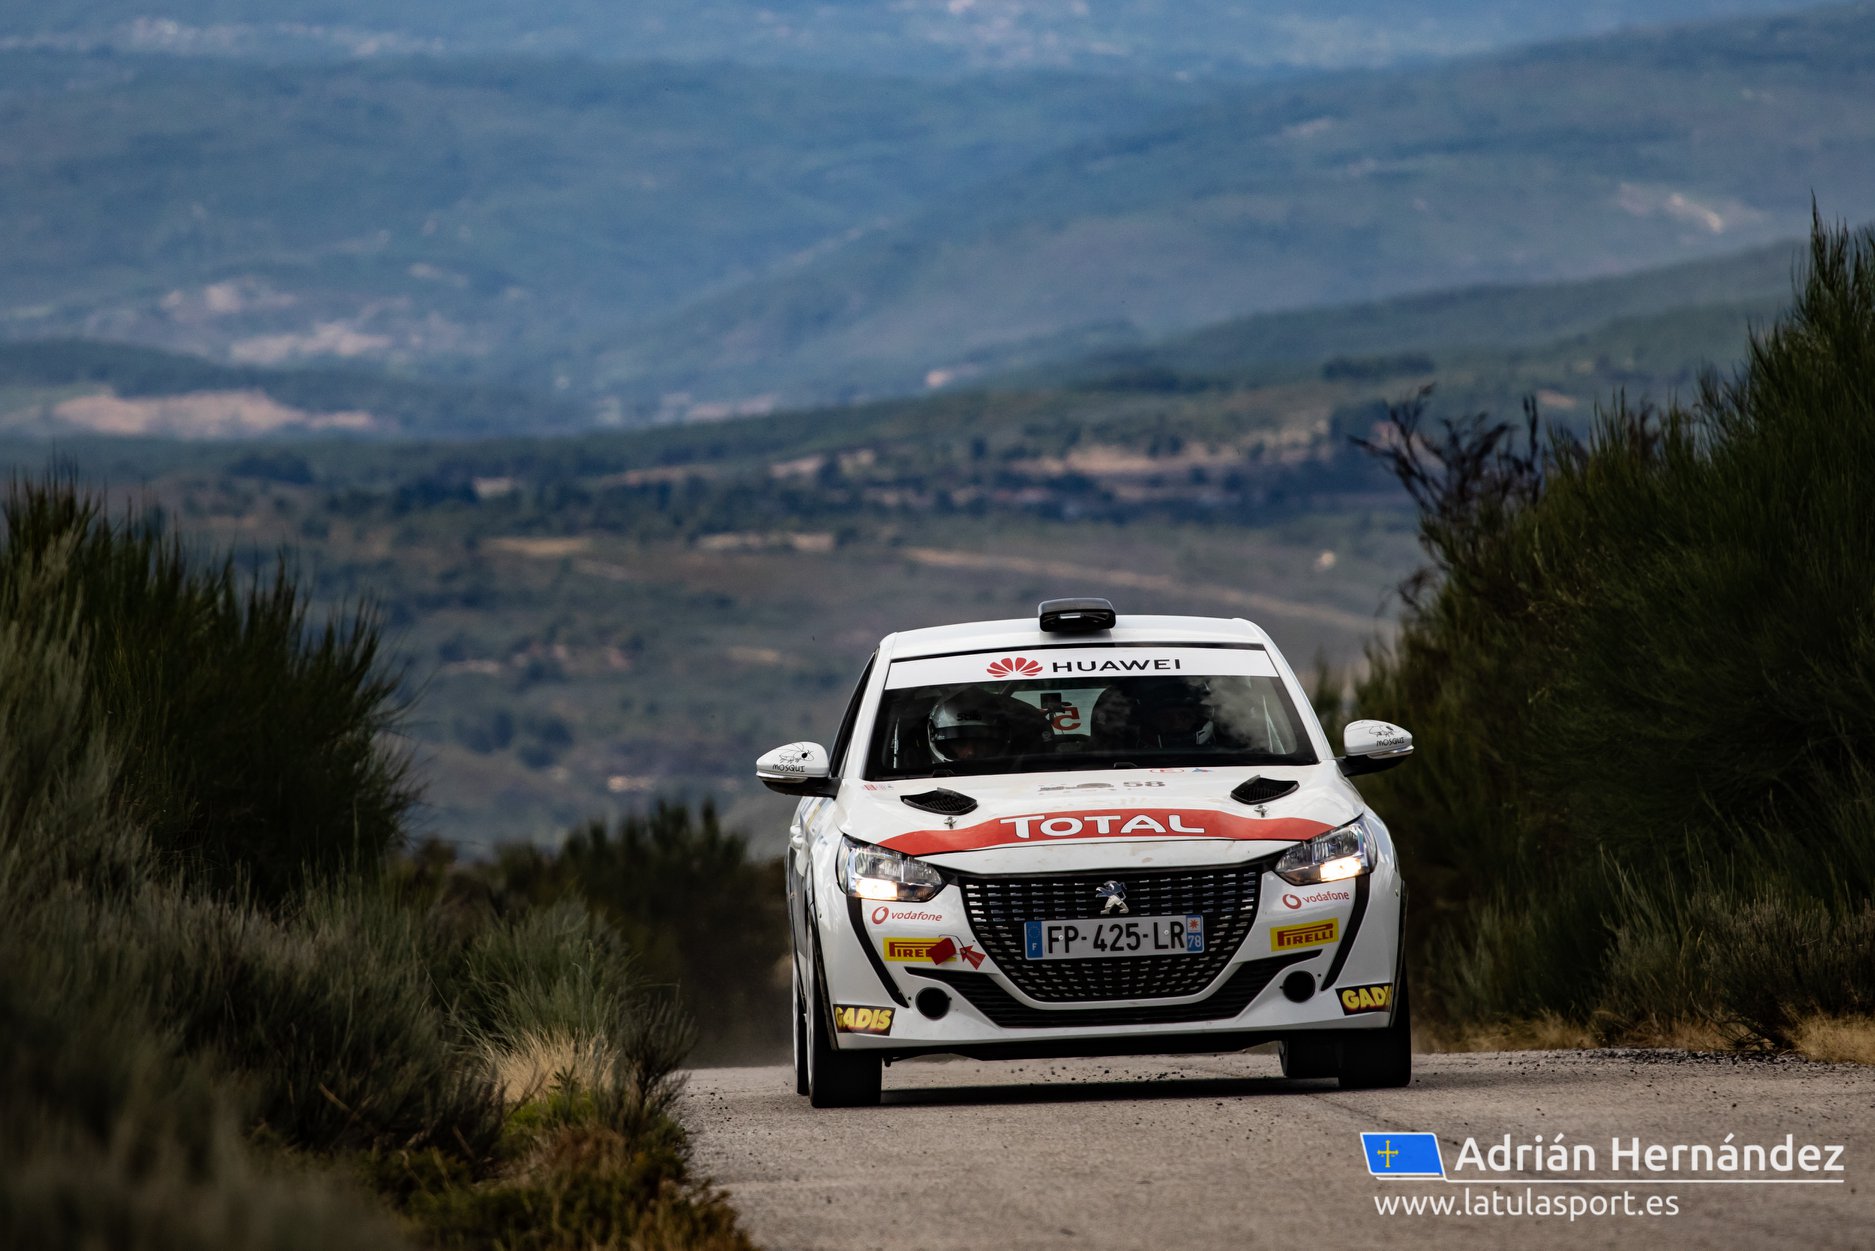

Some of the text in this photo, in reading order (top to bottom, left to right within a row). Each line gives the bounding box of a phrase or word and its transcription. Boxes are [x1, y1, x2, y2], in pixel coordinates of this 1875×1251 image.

[1052, 659, 1181, 673] HUAWEI
[1123, 780, 1166, 788] 58
[1000, 814, 1205, 839] TOTAL
[1303, 891, 1350, 904] vodafone
[891, 910, 943, 922] vodafone
[1277, 922, 1334, 947] PIRELLI
[1032, 942, 1037, 951] F
[1187, 935, 1202, 949] 78
[888, 941, 934, 958] PIRE
[1341, 985, 1391, 1010] GADI
